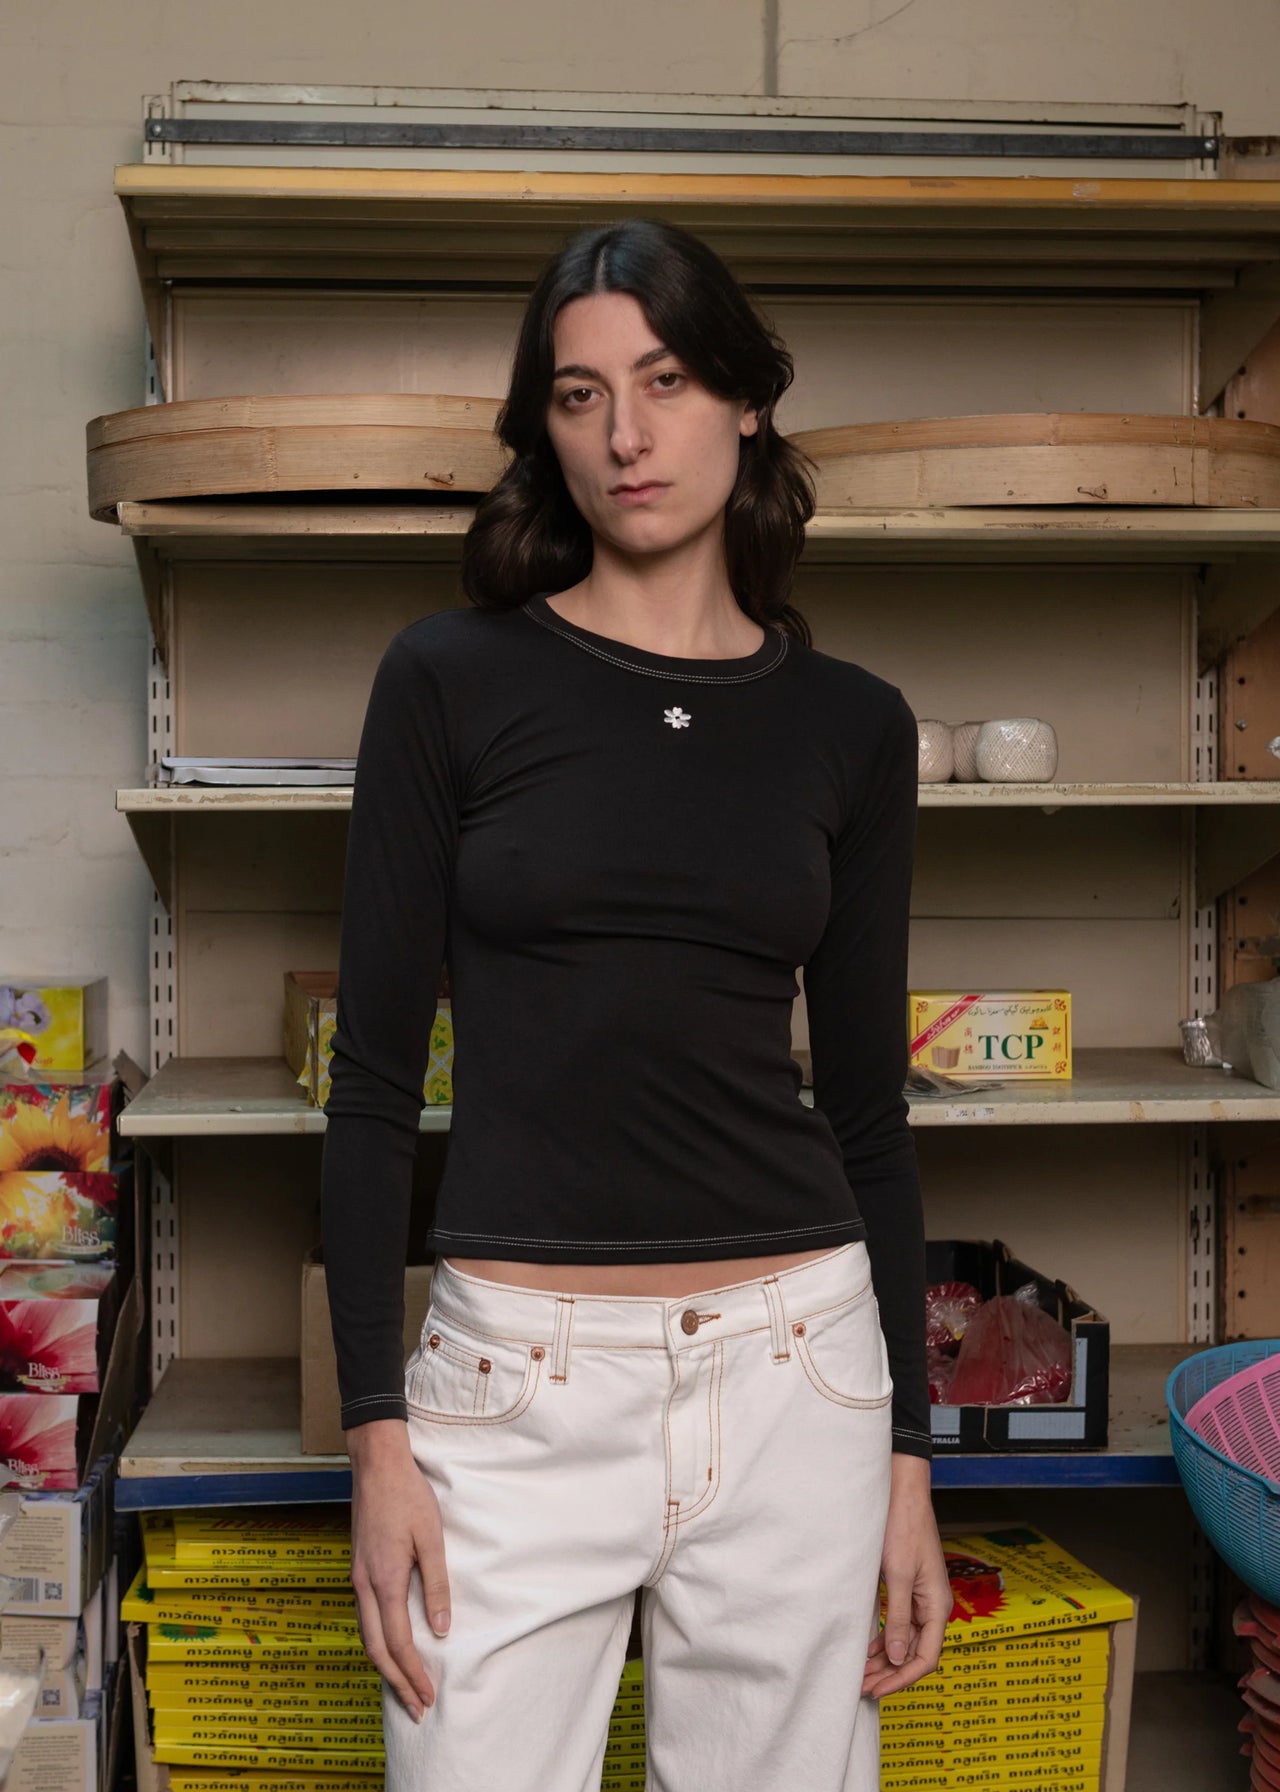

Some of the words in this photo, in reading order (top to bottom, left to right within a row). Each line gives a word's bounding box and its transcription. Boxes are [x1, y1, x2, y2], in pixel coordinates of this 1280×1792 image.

[978, 1034, 1044, 1060] TCP
[62, 1225, 100, 1247] Bliss
[28, 1362, 60, 1380] Bliss
[8, 1459, 40, 1476] Bliss
